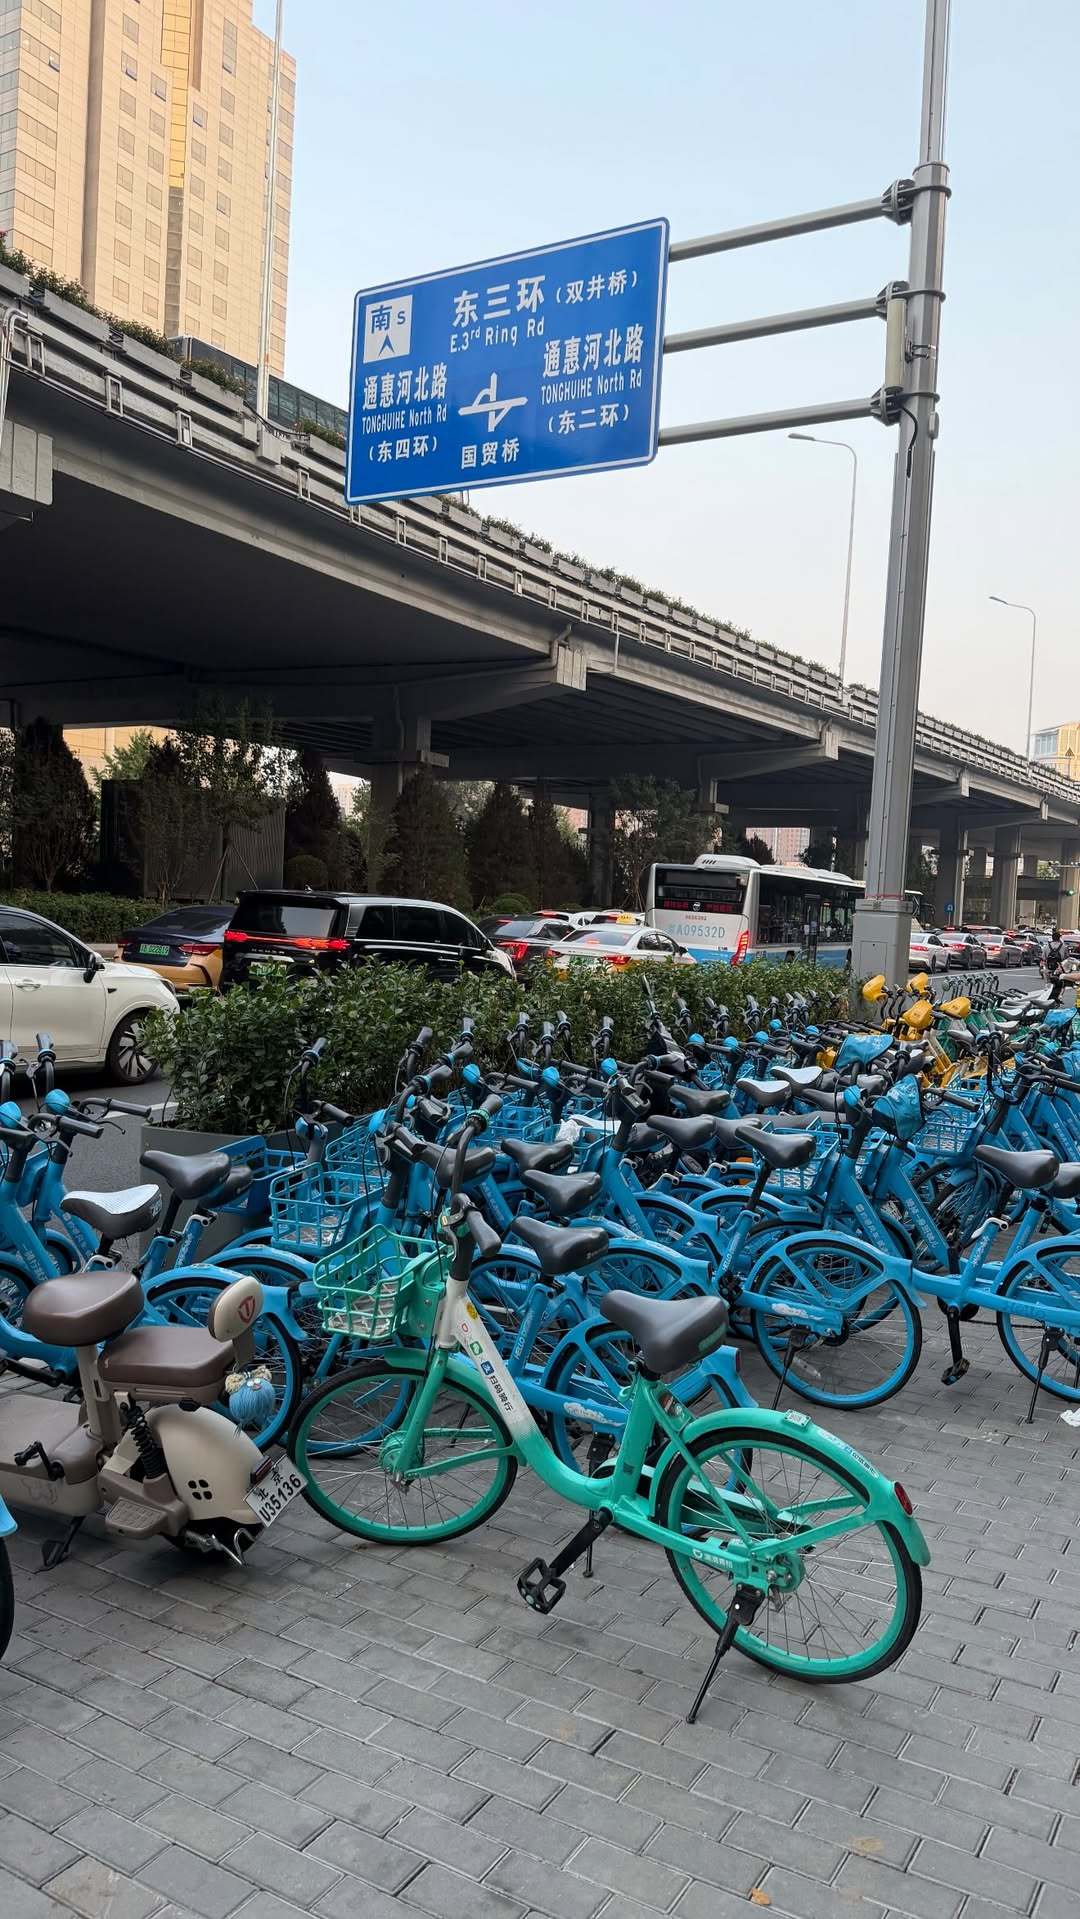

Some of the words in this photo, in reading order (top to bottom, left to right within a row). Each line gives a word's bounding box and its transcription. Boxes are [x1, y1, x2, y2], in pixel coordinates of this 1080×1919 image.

[452, 275, 546, 328] 东三环
[555, 269, 638, 304] （双井桥）
[370, 304, 393, 334] 南
[396, 311, 407, 325] S
[450, 326, 481, 353] E.3rd
[485, 324, 518, 347] Ring
[526, 316, 545, 338] Rd
[542, 323, 644, 379] 通惠河北路
[362, 362, 448, 411] 通惠河北路
[541, 377, 593, 405] TONGHUIHE
[597, 371, 624, 395] North
[630, 368, 642, 389] Rd
[362, 410, 406, 435] TONGHUIHE
[408, 405, 433, 428] North
[436, 403, 448, 423] Rd
[548, 402, 630, 435] （东二环）
[369, 435, 437, 463] （东四环）
[461, 438, 520, 470] 国贸桥
[259, 1473, 302, 1522] U35136
